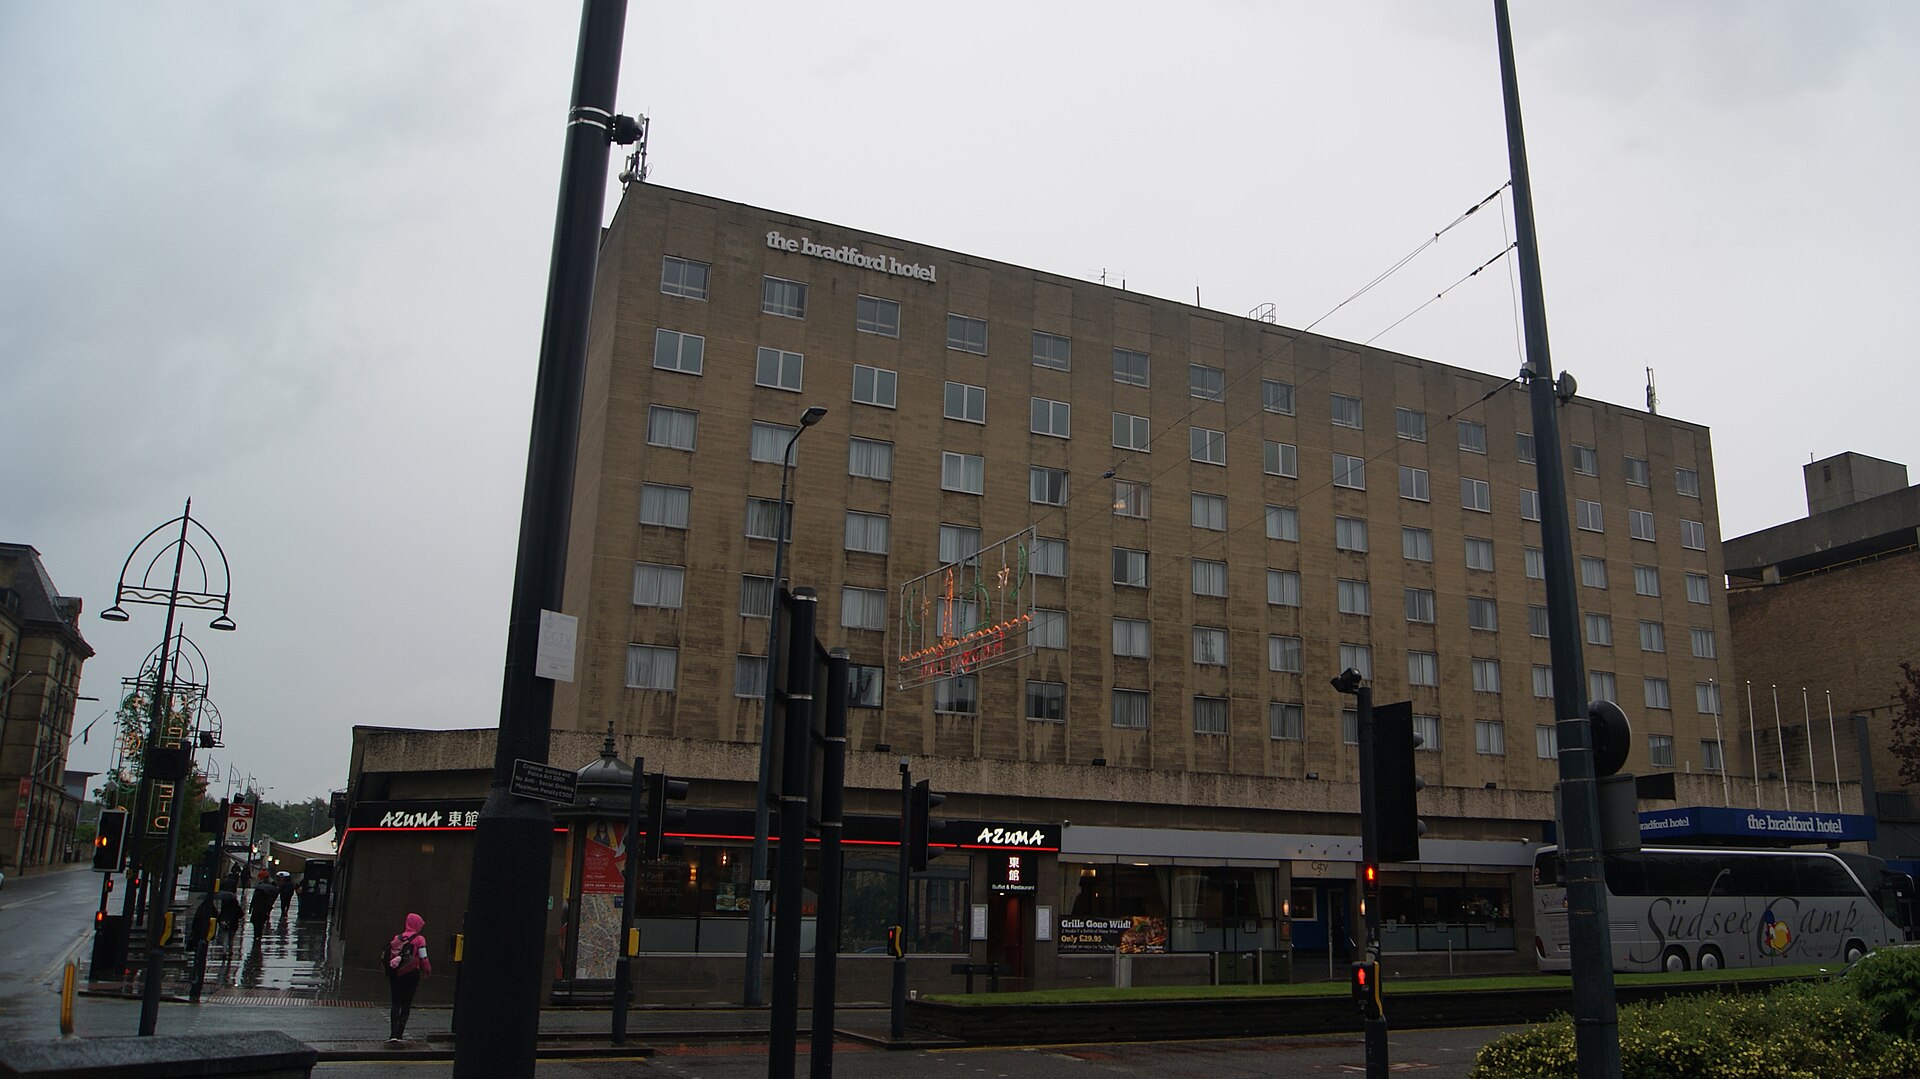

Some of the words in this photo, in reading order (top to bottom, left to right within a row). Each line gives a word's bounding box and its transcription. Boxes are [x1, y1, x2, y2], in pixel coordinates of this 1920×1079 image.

[766, 231, 798, 252] the
[801, 237, 887, 273] bradford
[888, 256, 937, 283] hotel
[233, 820, 247, 831] M
[380, 811, 442, 828] AZUMA
[448, 811, 480, 827] 東館
[1640, 818, 1669, 830] radford
[1669, 816, 1690, 828] hotel
[1747, 814, 1766, 830] the
[1767, 815, 1815, 832] bradford
[1816, 817, 1843, 834] hotel
[977, 827, 1045, 846] AZUMA
[1311, 861, 1329, 872] City
[1629, 868, 1753, 964] Südsee
[1757, 896, 1865, 960] Camp
[1061, 919, 1085, 929] Grills
[1085, 920, 1108, 929] Gone
[1109, 920, 1131, 929] Wild!
[1061, 935, 1078, 944] Only
